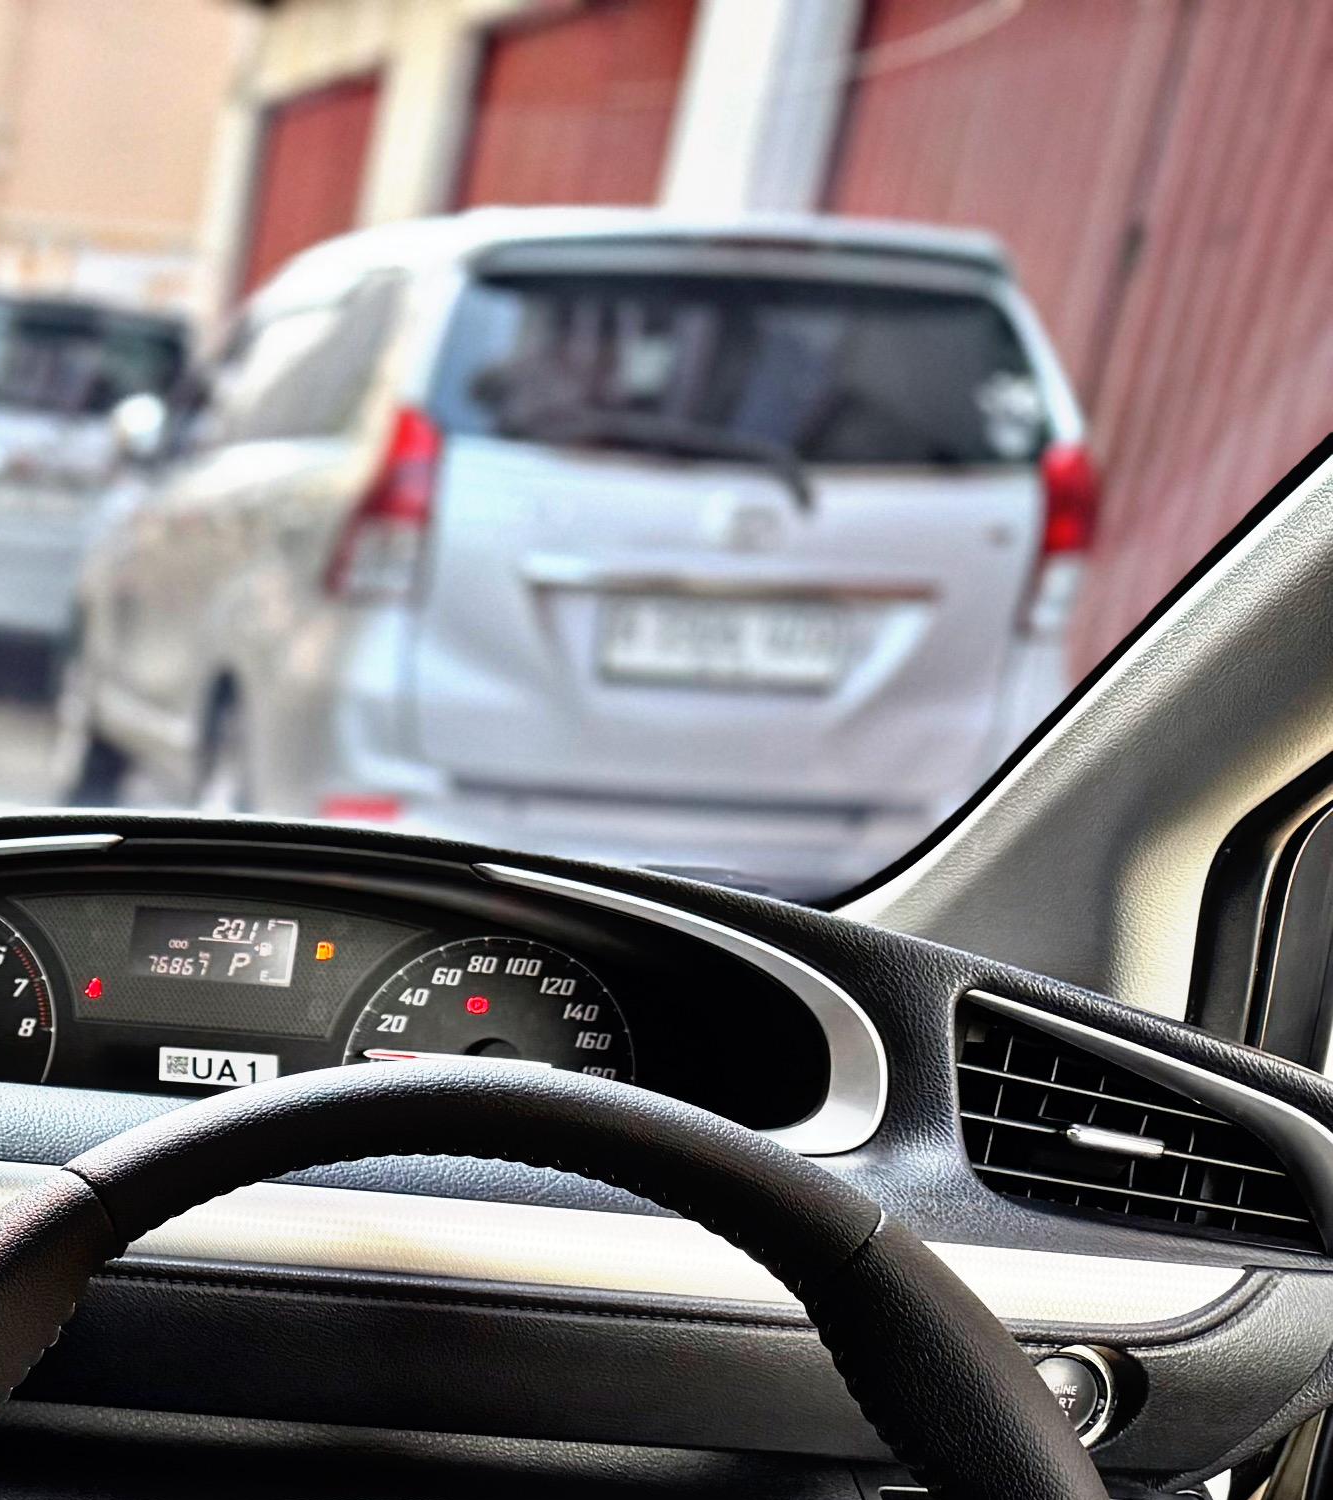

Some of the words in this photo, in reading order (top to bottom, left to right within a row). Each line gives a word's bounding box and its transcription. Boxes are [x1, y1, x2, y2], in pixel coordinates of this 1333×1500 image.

[148, 954, 210, 976] 76867
[227, 952, 251, 976] P
[467, 955, 498, 974] 80
[505, 957, 542, 977] 100
[431, 967, 463, 987] 60
[540, 976, 576, 997] 120
[13, 978, 29, 997] 7
[398, 988, 430, 1006] 40
[563, 1003, 600, 1022] 140
[18, 1018, 36, 1037] 8
[376, 1014, 408, 1033] 20
[575, 1030, 612, 1050] 160
[1051, 1384, 1078, 1396] GINE
